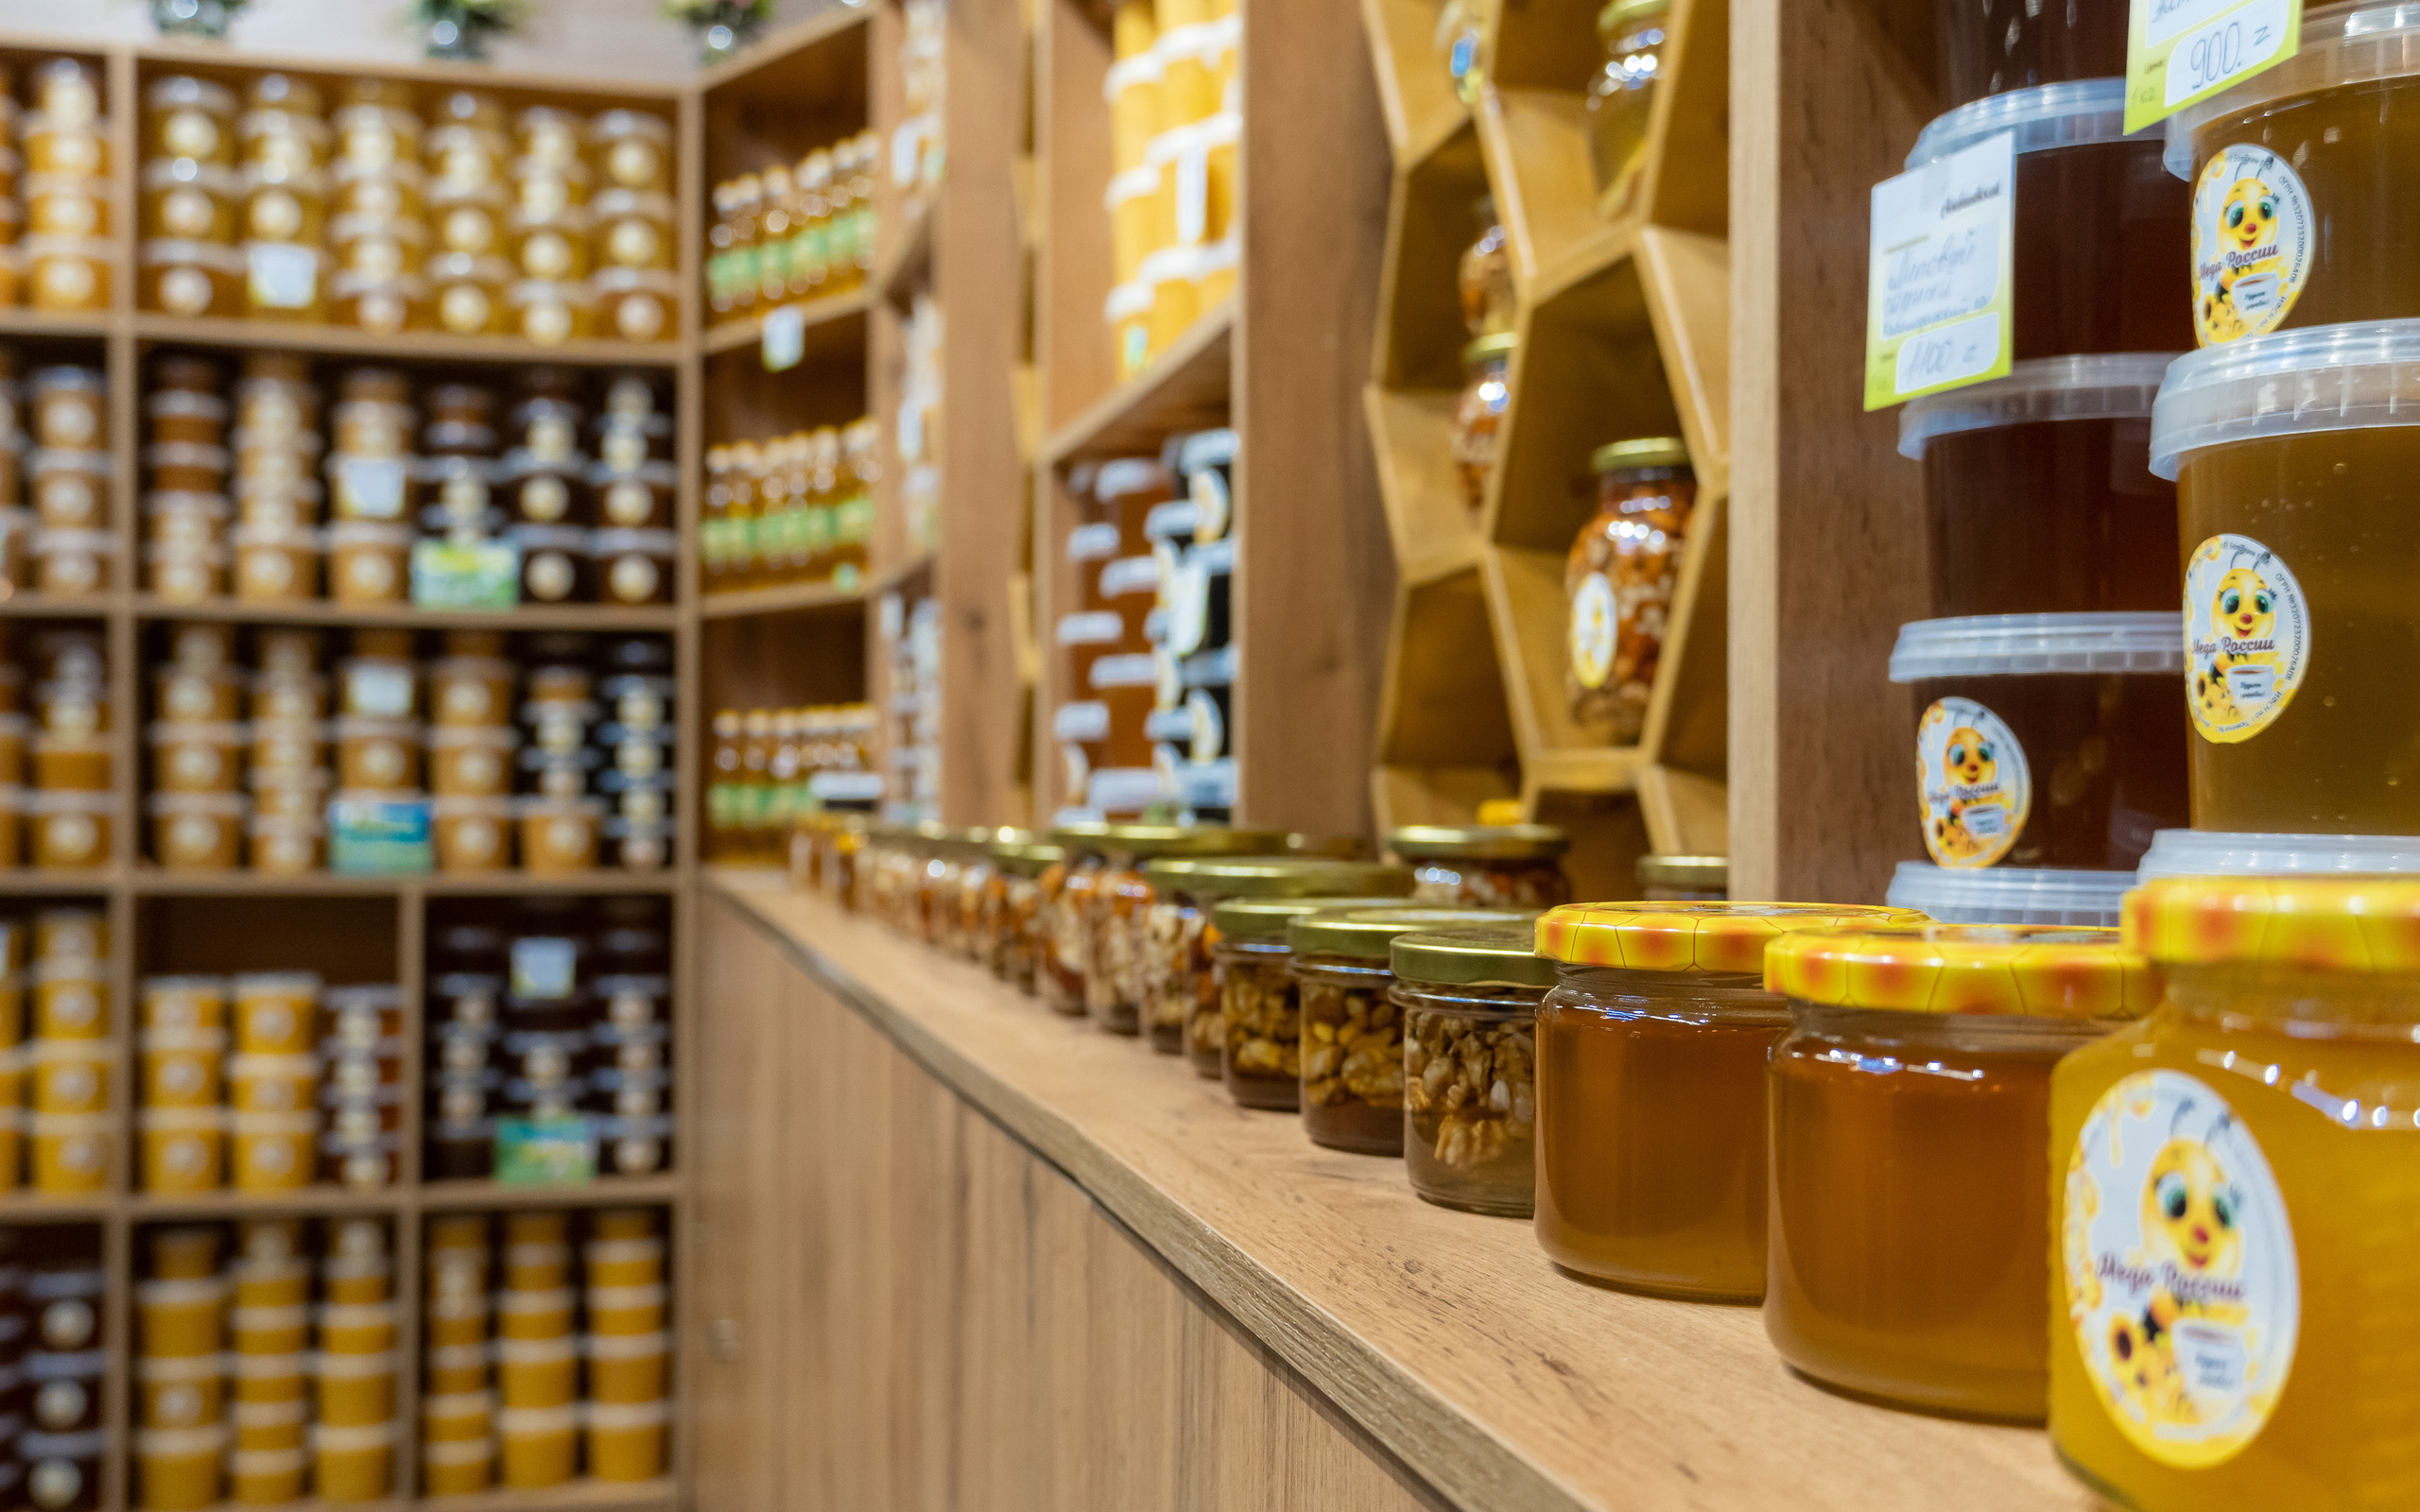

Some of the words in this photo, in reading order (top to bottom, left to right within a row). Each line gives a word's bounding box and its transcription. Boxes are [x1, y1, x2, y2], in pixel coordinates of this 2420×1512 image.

[2277, 176, 2294, 197] ОГРН
[2225, 244, 2279, 267] России
[2274, 572, 2291, 593] ОГРН
[2221, 636, 2275, 653] России
[2096, 1252, 2153, 1296] Меда
[2161, 1260, 2245, 1301] России
